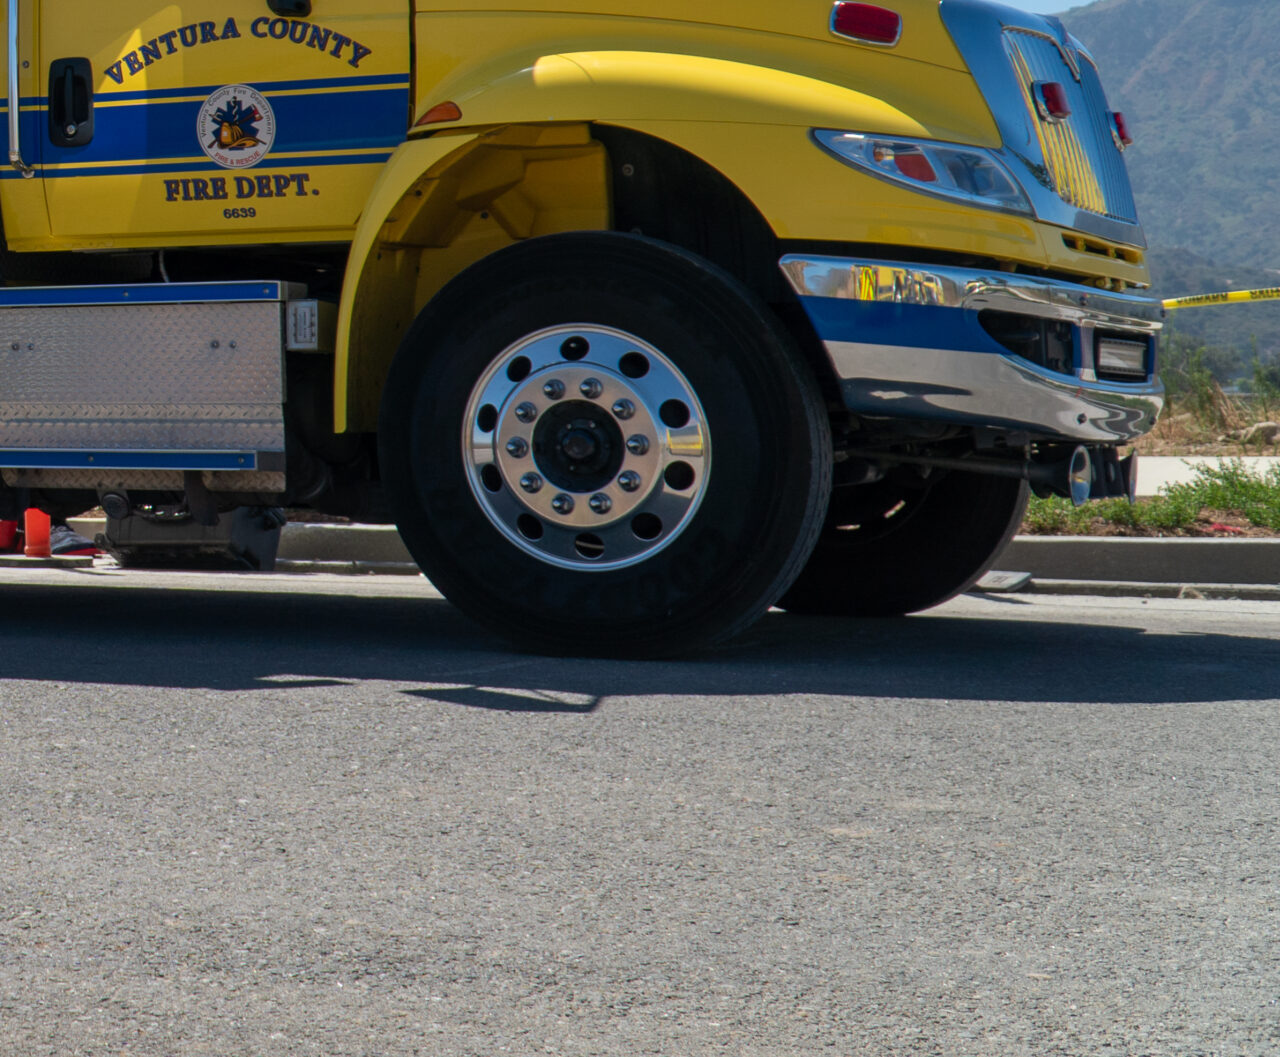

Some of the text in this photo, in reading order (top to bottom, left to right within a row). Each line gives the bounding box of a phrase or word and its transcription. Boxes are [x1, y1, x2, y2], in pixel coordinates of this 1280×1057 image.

[104, 17, 372, 85] VENTURA COUNTY
[201, 87, 273, 138] Ventura County Fire Department
[214, 151, 229, 164] FIRE
[236, 150, 261, 165] RESCUE
[163, 173, 320, 202] FIRE DEPT.
[223, 207, 257, 219] 6639
